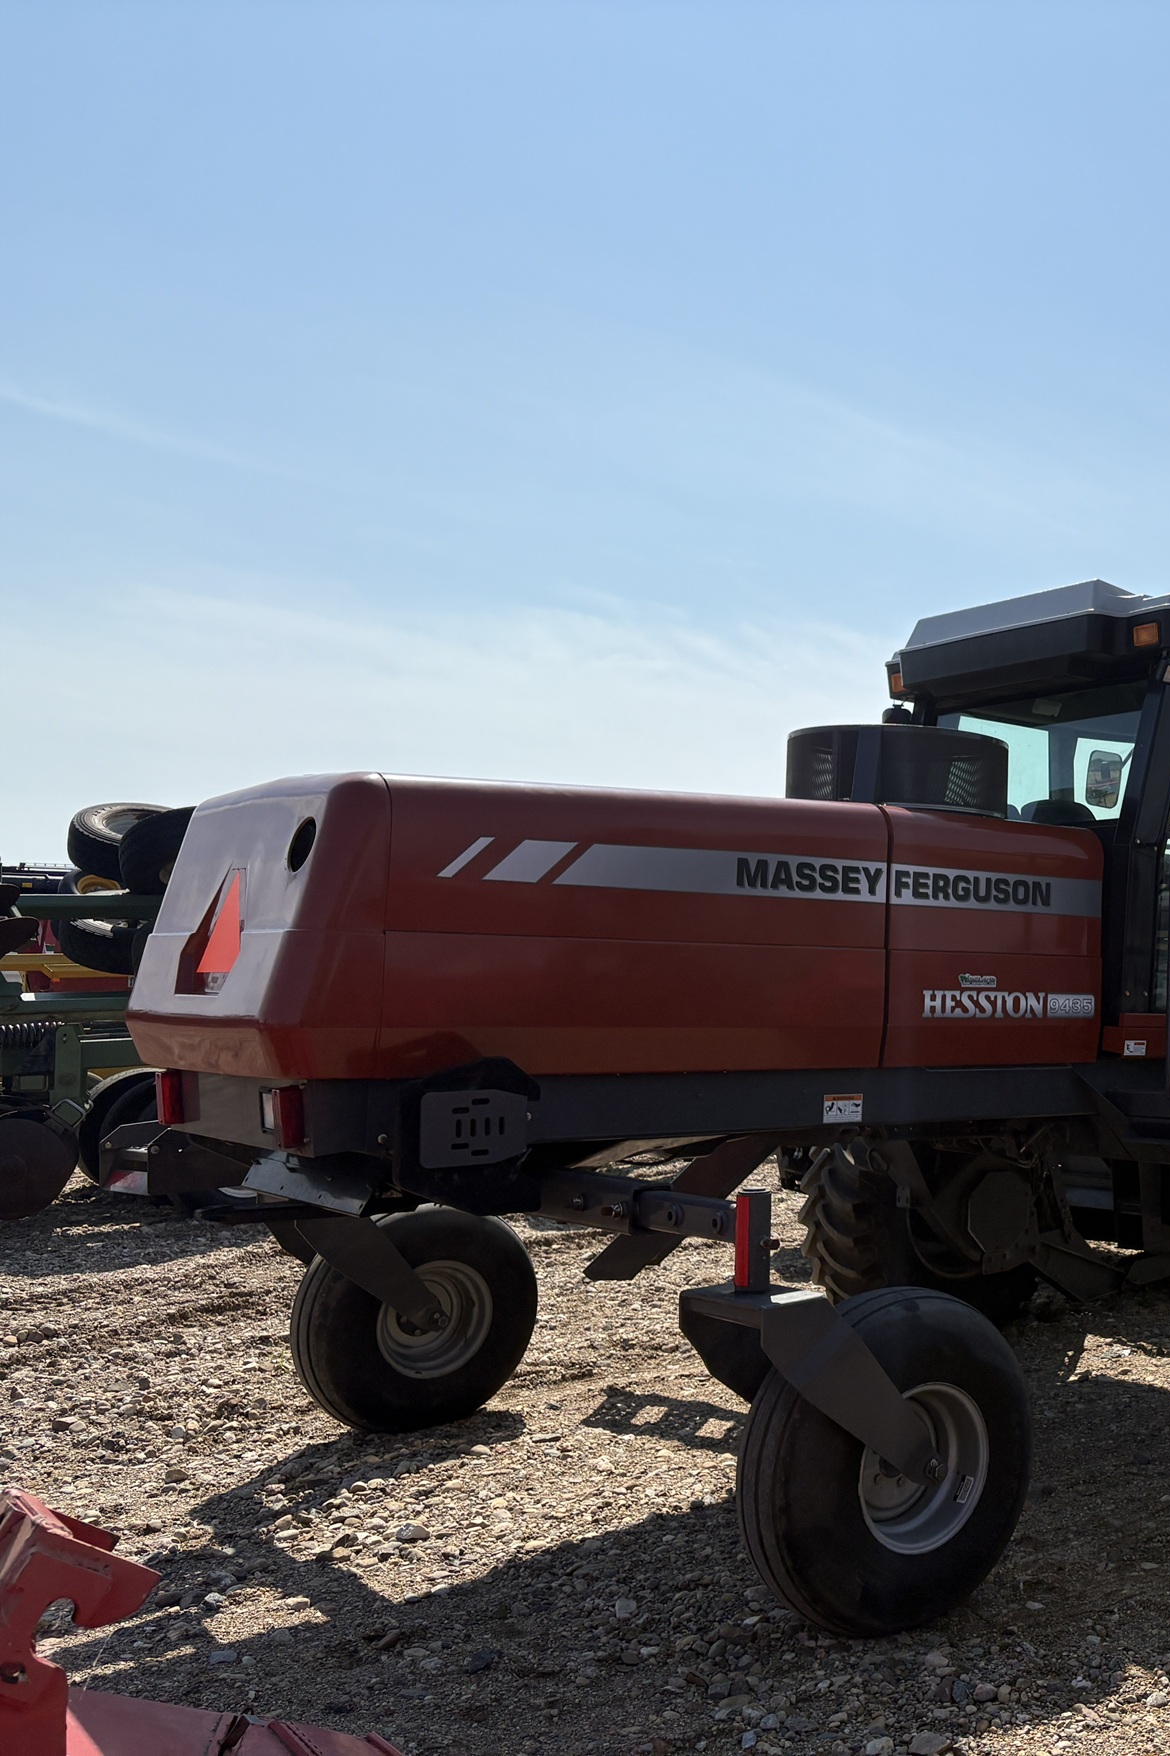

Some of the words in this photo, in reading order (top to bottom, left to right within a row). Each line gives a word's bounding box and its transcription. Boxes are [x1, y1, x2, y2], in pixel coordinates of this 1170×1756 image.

[736, 857, 883, 897] MASSEY
[894, 869, 1052, 907] FERGUSON
[922, 989, 1045, 1019] HESSTON
[1049, 998, 1093, 1014] 9435
